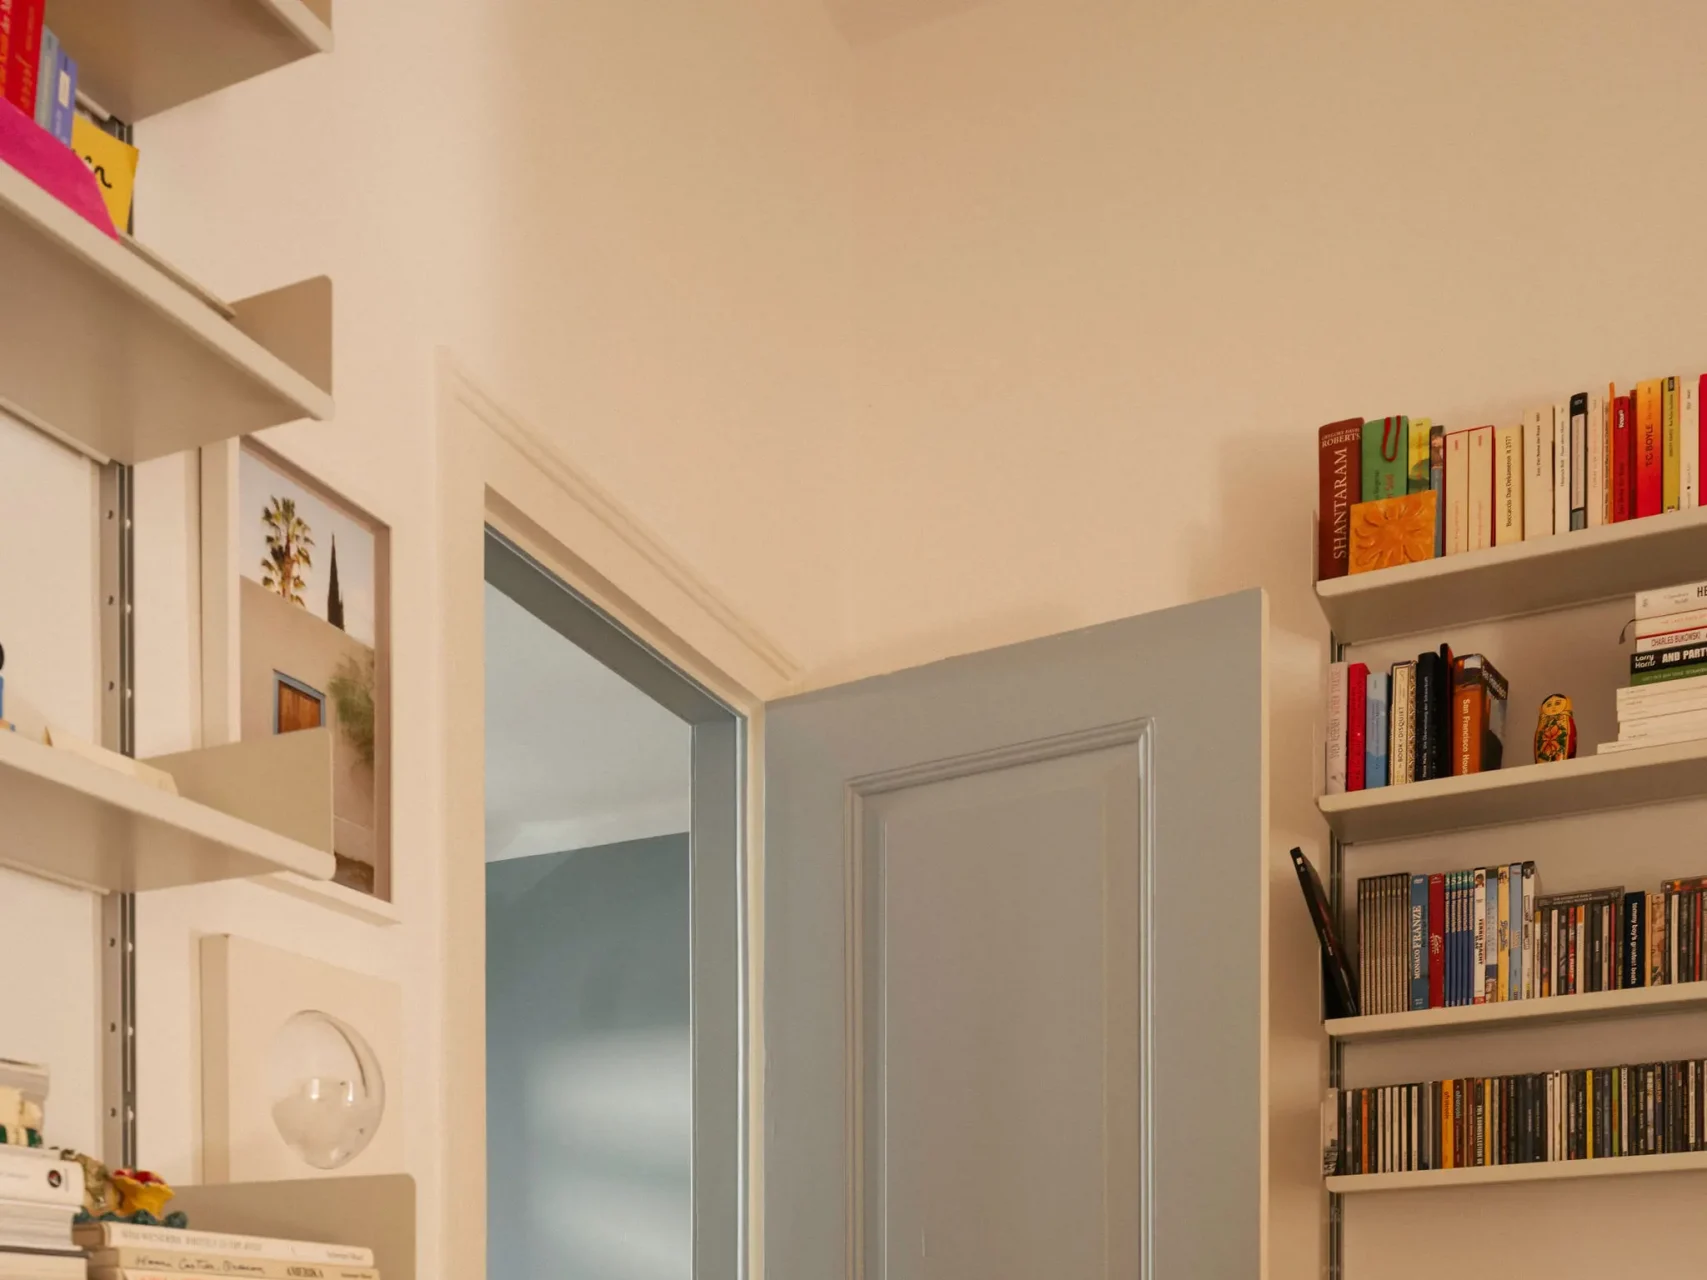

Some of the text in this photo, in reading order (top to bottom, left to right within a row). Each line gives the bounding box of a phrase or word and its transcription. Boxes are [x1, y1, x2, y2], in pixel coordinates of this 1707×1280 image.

[1322, 432, 1361, 448] ROBERTS
[1646, 424, 1654, 452] BOYLE
[1334, 448, 1348, 559] SHANTARAM
[1652, 631, 1701, 647] CHARLES BUKOWSKI
[1635, 654, 1654, 662] Larry
[1662, 647, 1707, 663] AND PART
[1635, 660, 1656, 668] Harris
[1462, 698, 1470, 775] San Francisco Hous
[1630, 902, 1638, 924] tommy
[1412, 905, 1422, 948] FRANZE
[1630, 924, 1638, 940] boy's
